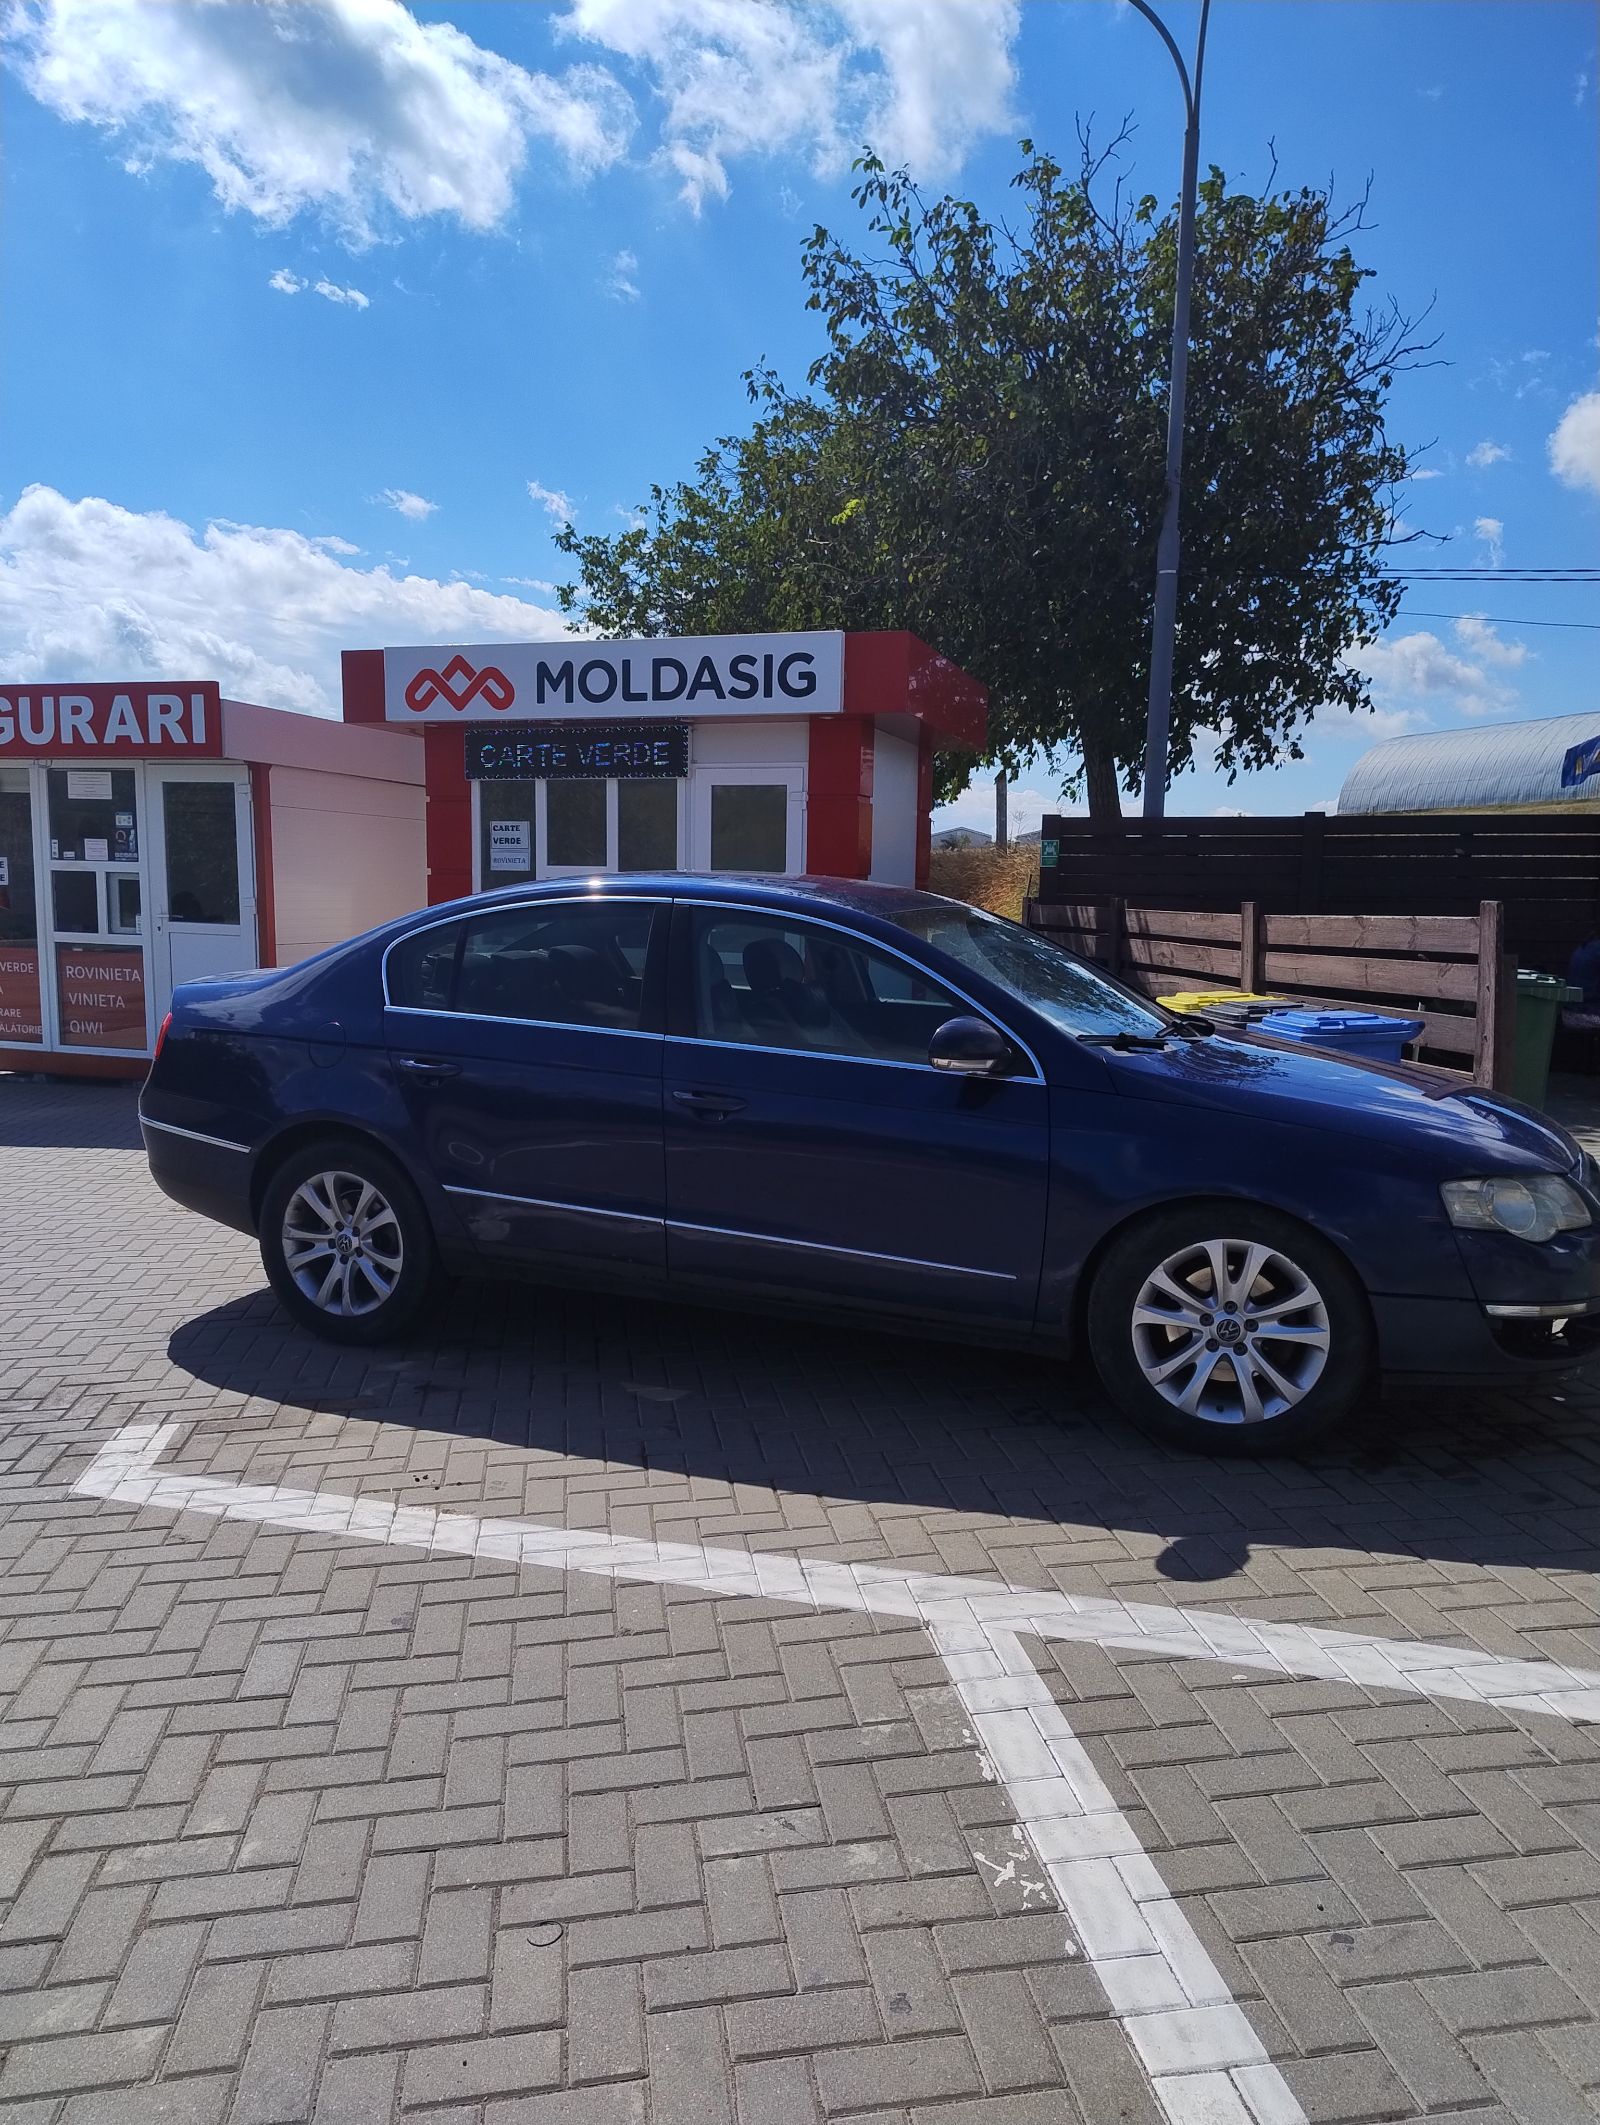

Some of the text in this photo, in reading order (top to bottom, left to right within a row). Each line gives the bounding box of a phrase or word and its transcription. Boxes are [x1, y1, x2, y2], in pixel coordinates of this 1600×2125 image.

[536, 652, 817, 704] MOLDASIG
[479, 741, 670, 768] CARTE VERDE
[492, 824, 521, 832] CARTE
[492, 837, 522, 845] VERDE
[65, 965, 142, 982] ROVINIETA
[68, 992, 126, 1009] VINIETA
[69, 1019, 104, 1035] QIWI
